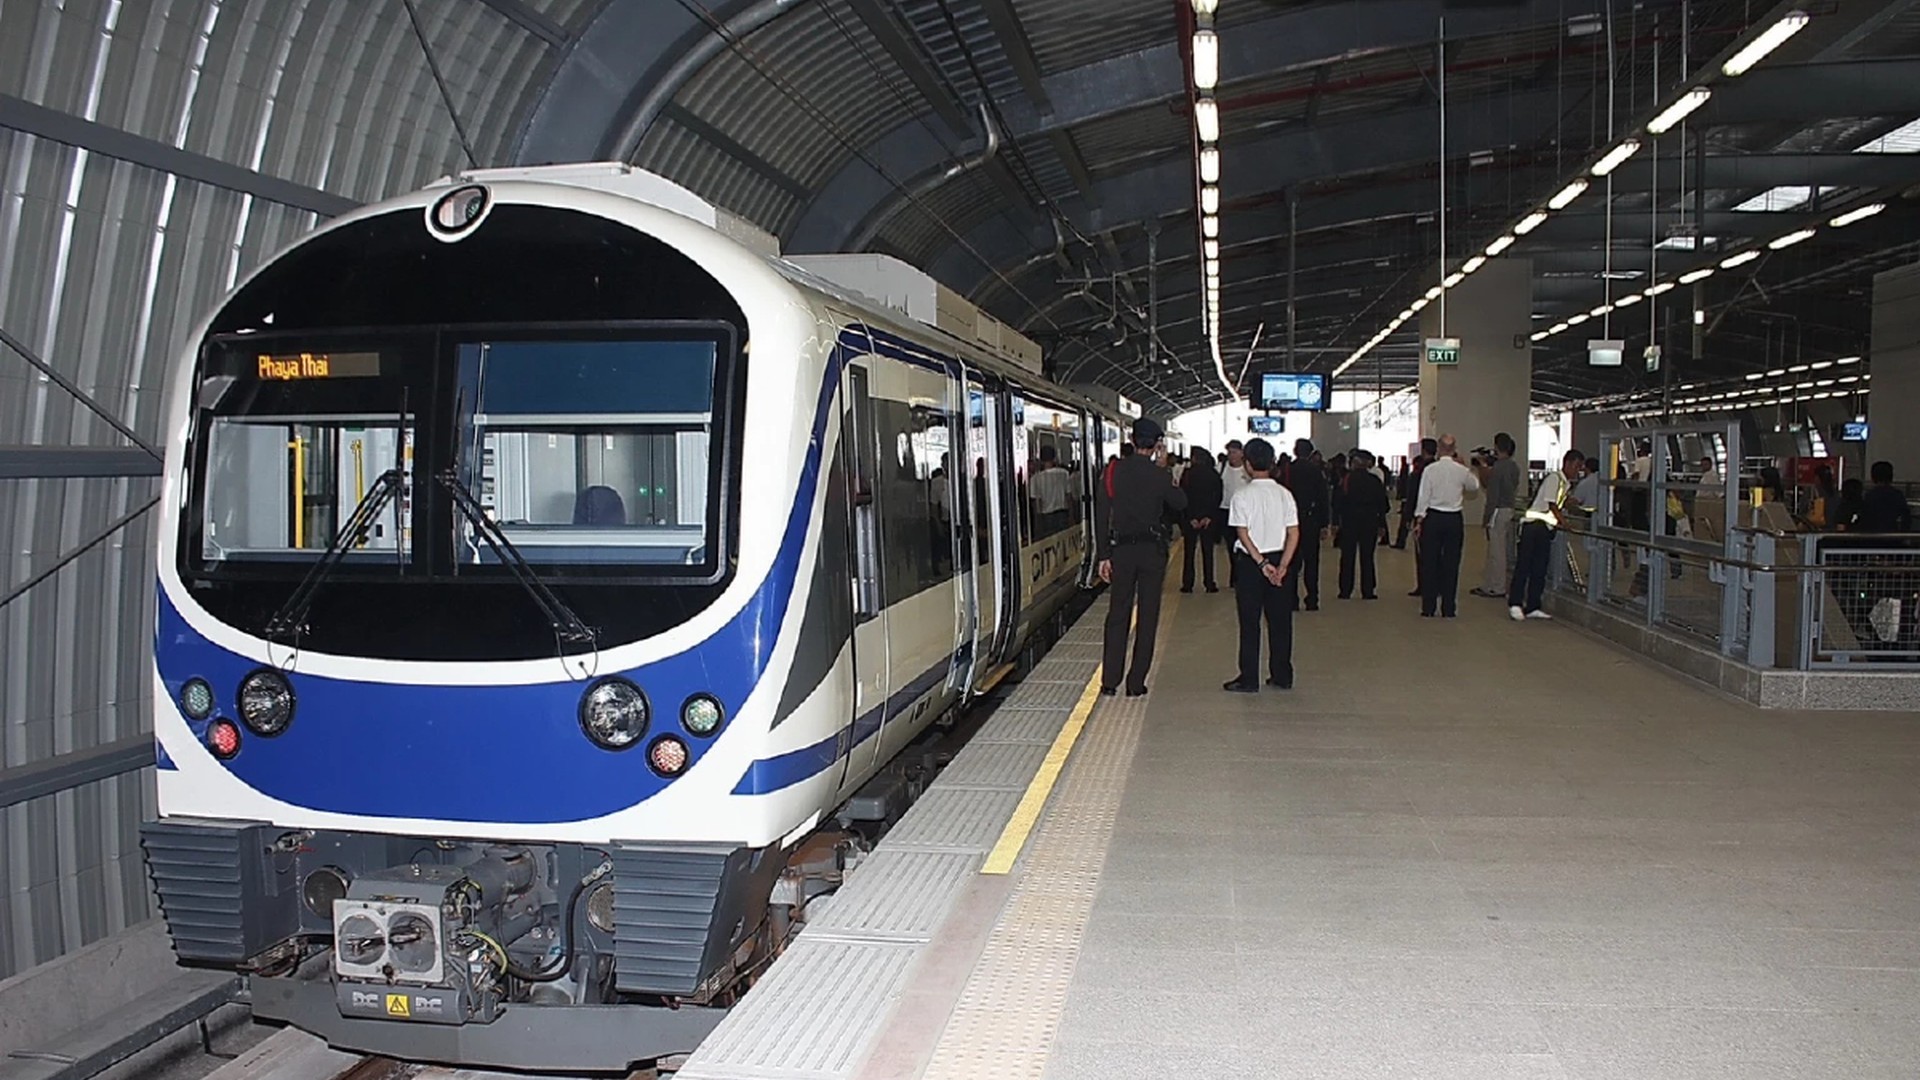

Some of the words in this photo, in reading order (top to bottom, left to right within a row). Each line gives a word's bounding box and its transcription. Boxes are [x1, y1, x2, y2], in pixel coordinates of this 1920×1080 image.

[258, 355, 299, 380] Phaya
[301, 353, 328, 376] Thai
[1429, 350, 1456, 361] EXIT
[1031, 541, 1060, 582] CITY
